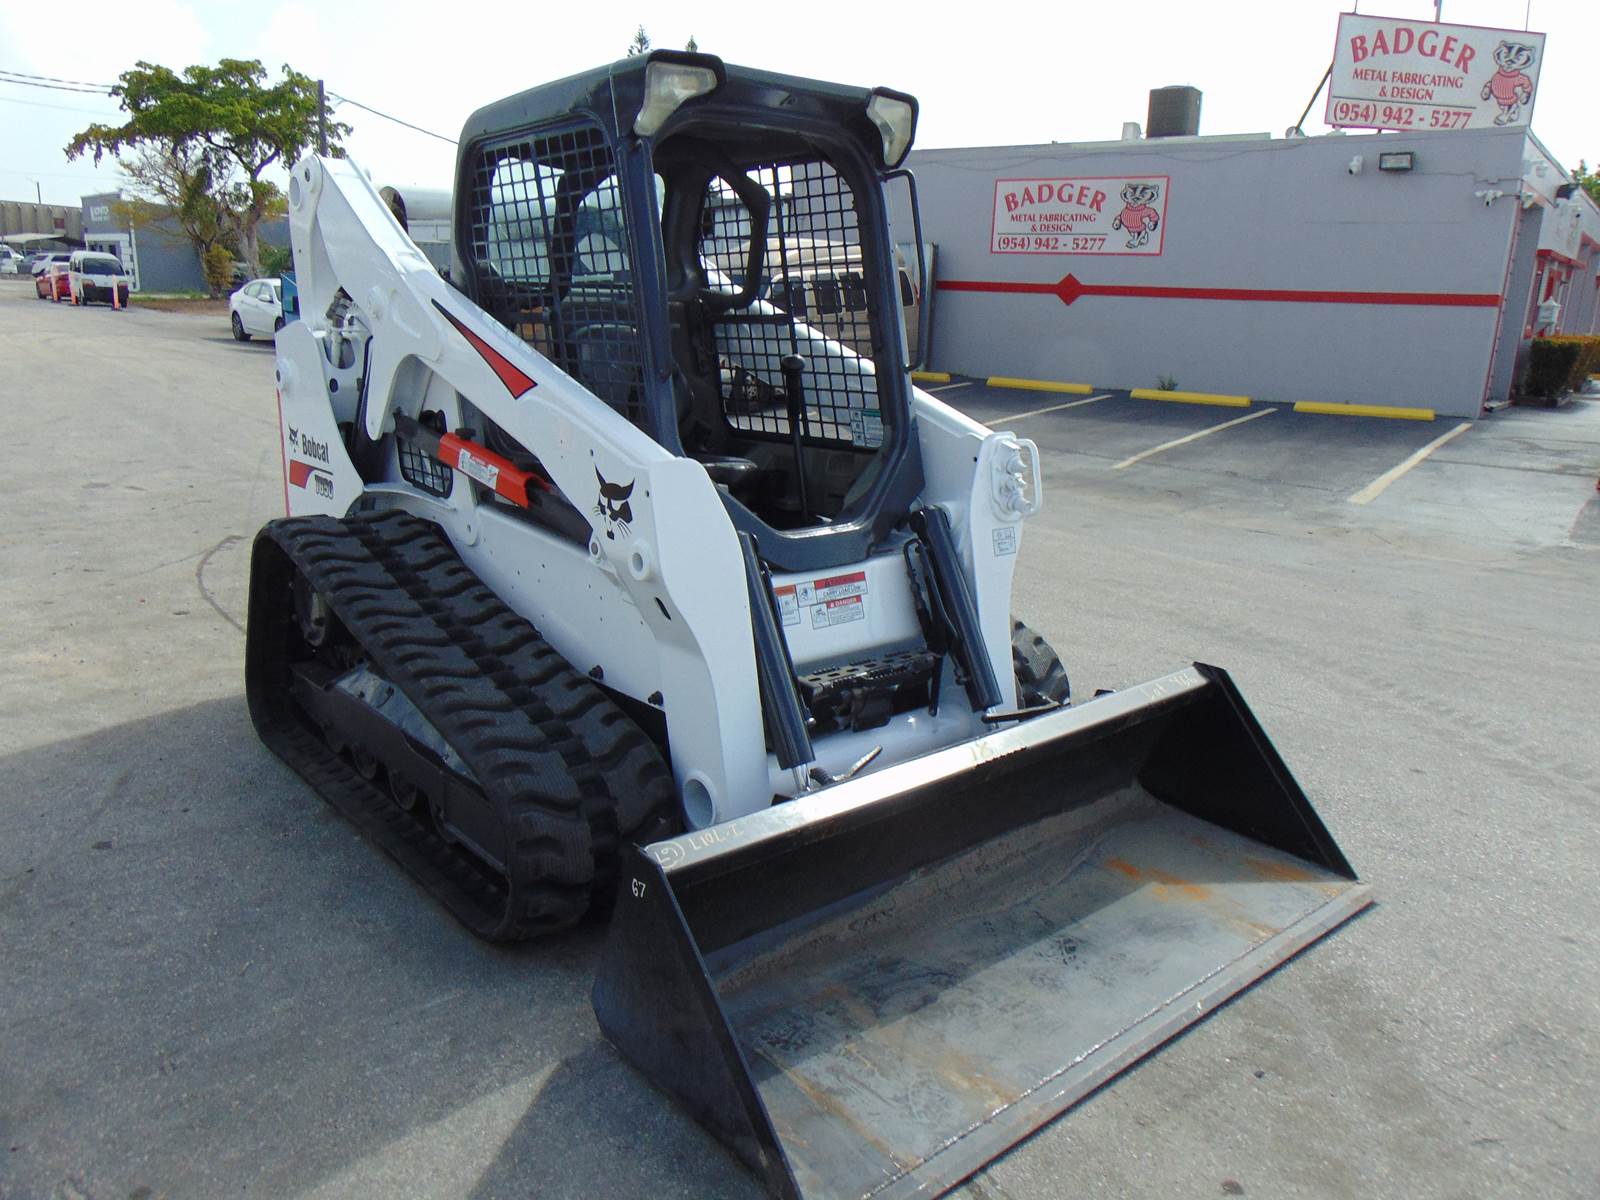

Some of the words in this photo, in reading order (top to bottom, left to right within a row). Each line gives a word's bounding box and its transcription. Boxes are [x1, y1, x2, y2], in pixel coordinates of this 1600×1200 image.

[1350, 27, 1476, 74] BADGER
[1352, 68, 1388, 82] METAL
[1391, 71, 1464, 89] FABRICATING
[1378, 86, 1387, 97] &
[1390, 87, 1434, 100] DESIGN
[1333, 102, 1377, 122] (954)
[1382, 106, 1414, 125] 942
[1429, 110, 1473, 129] 5277
[1004, 183, 1107, 213] BADGER
[1010, 213, 1036, 223] METAL
[1039, 212, 1097, 222] FABRICATING
[1030, 223, 1038, 232] &
[1039, 223, 1073, 233] DESIGN
[997, 237, 1031, 251] (954)
[1034, 237, 1059, 250] 942
[1071, 237, 1107, 250] 5277
[301, 433, 330, 464] Bobcat
[631, 878, 646, 898] 67
